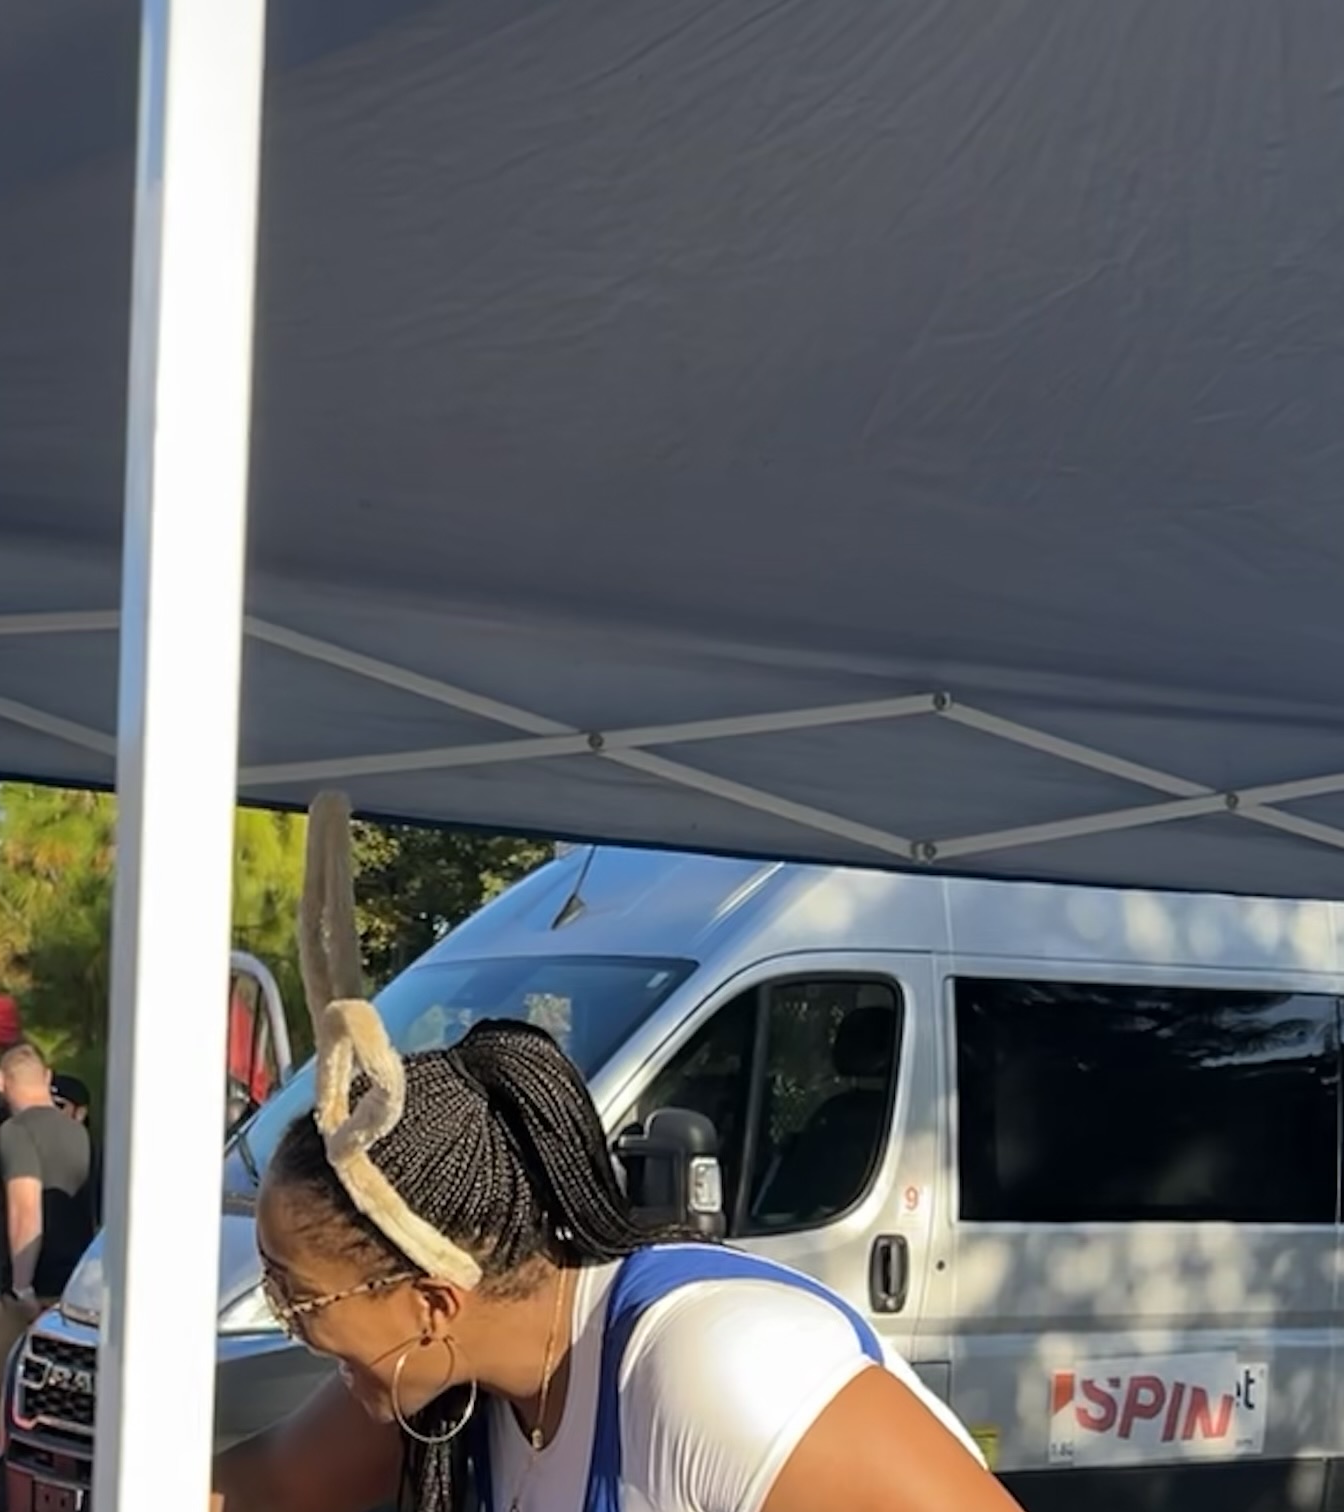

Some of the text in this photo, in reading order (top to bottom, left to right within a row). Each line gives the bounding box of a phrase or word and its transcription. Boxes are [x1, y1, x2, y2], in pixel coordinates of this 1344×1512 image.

[905, 1186, 919, 1211] 9
[49, 1364, 93, 1394] RA
[1075, 1375, 1234, 1442] SPIN
